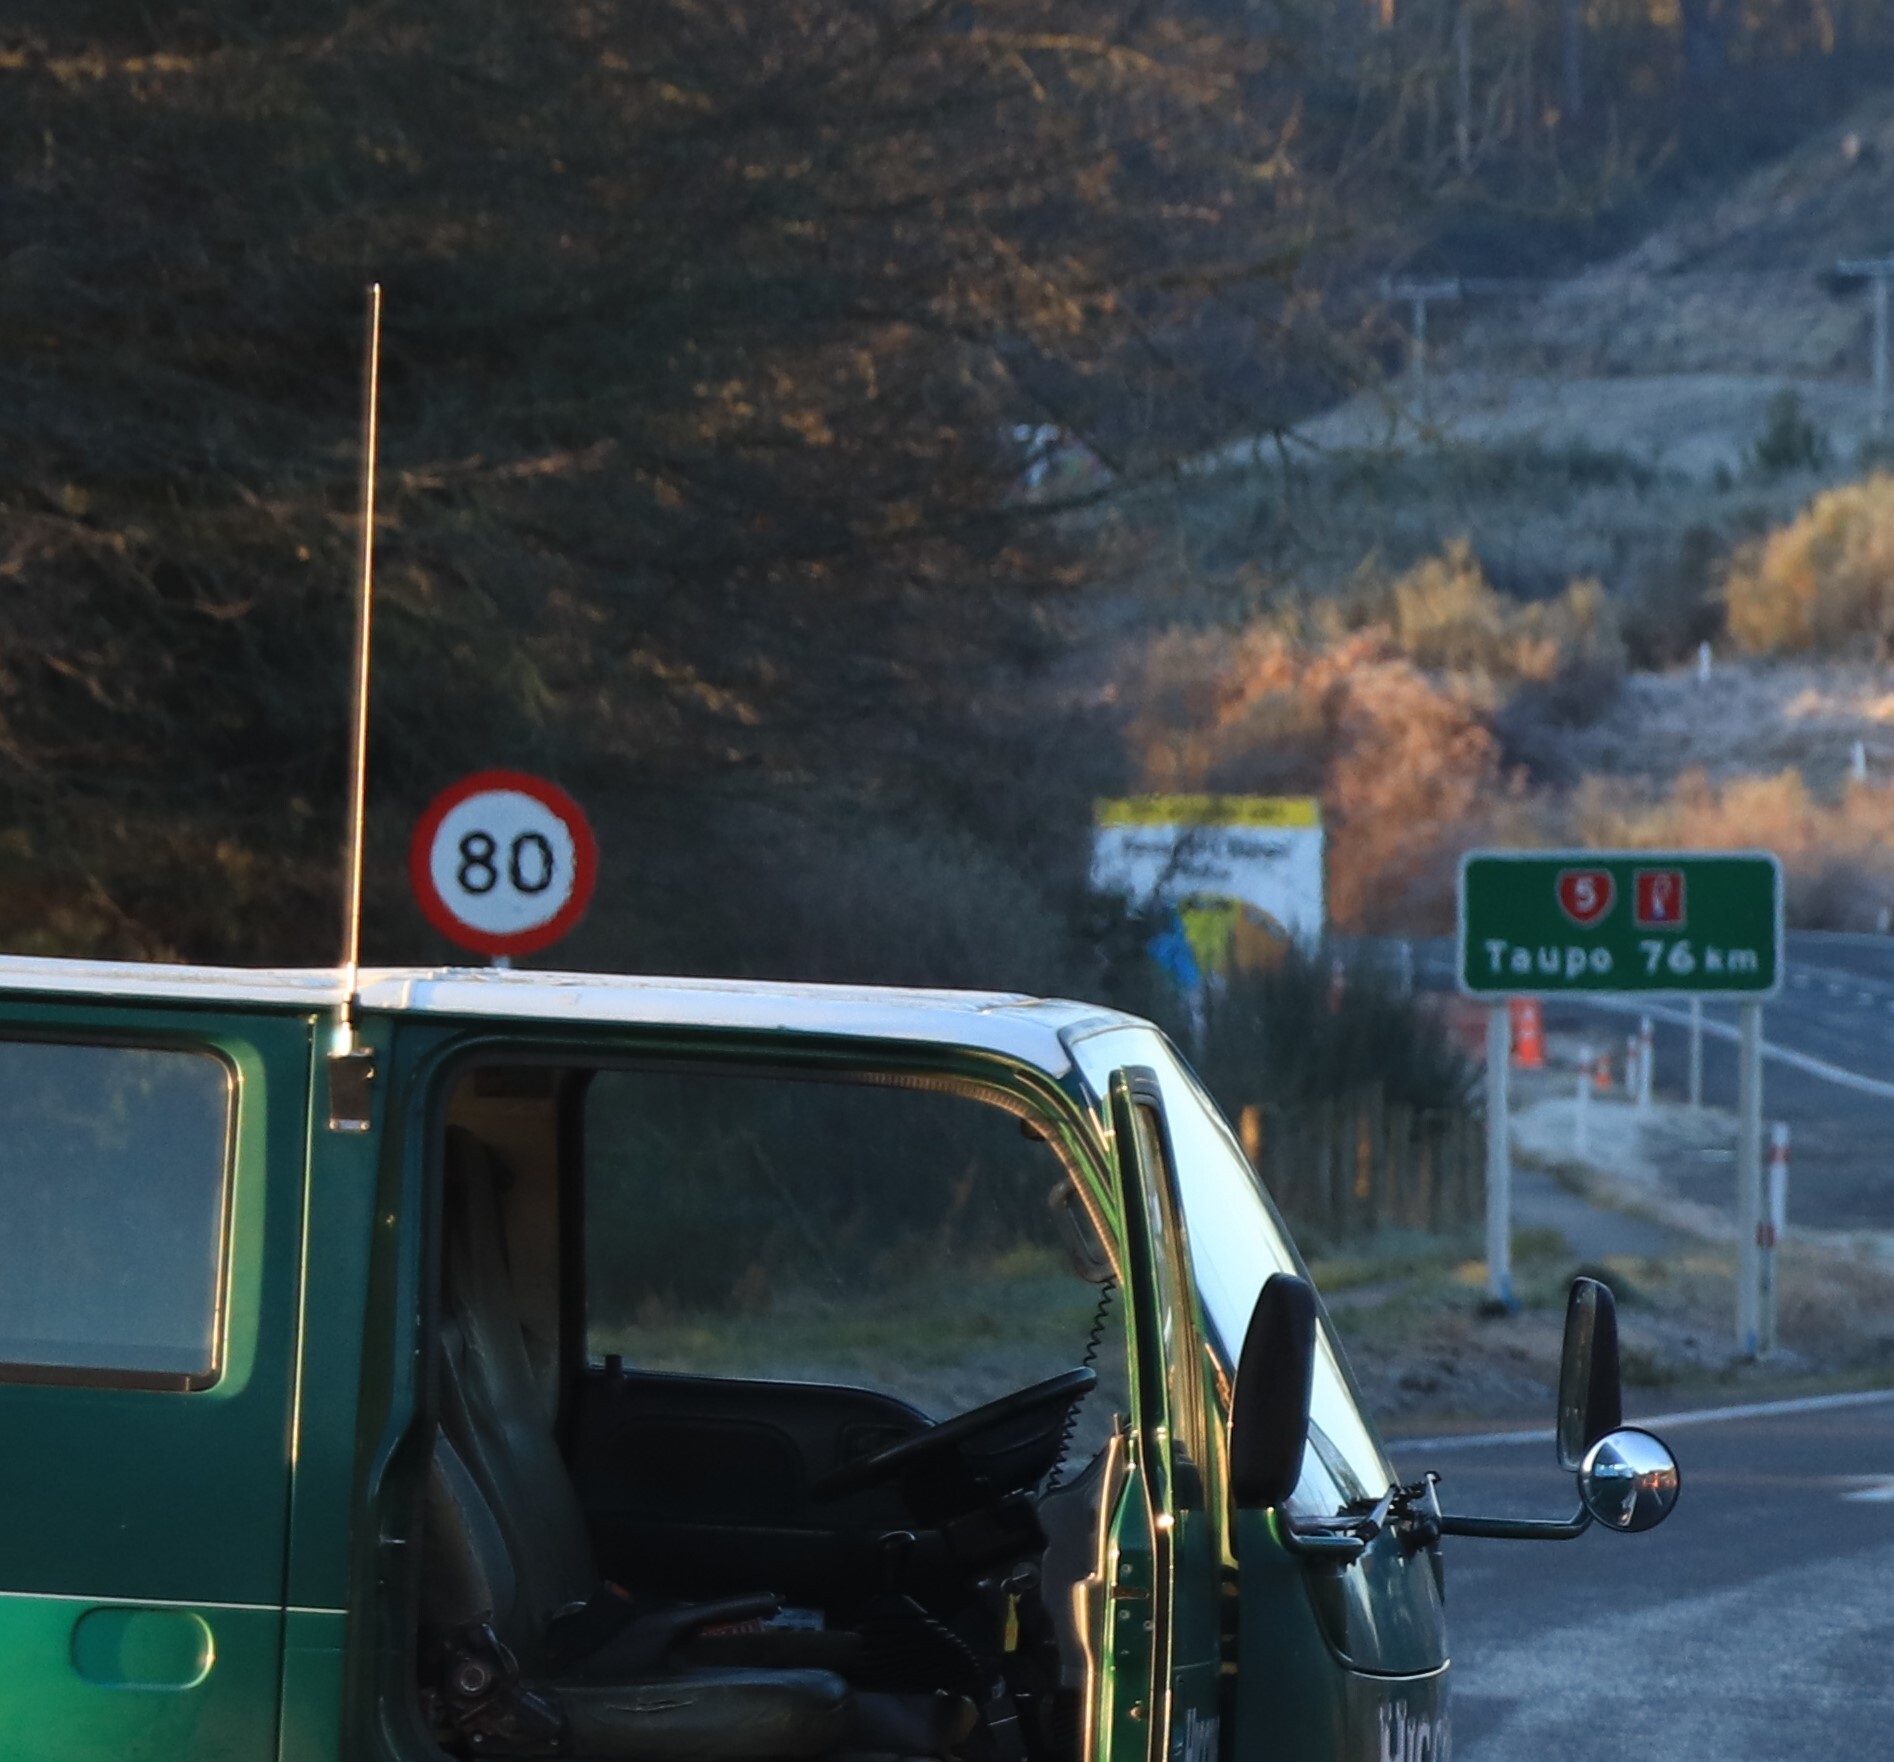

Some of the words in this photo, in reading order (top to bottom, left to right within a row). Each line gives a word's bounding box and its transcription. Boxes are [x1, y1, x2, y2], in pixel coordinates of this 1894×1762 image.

[458, 830, 554, 896] 80
[1574, 876, 1598, 913] 5
[1485, 938, 1613, 978] Taupo
[1638, 938, 1696, 975] 76
[1704, 945, 1759, 974] km
